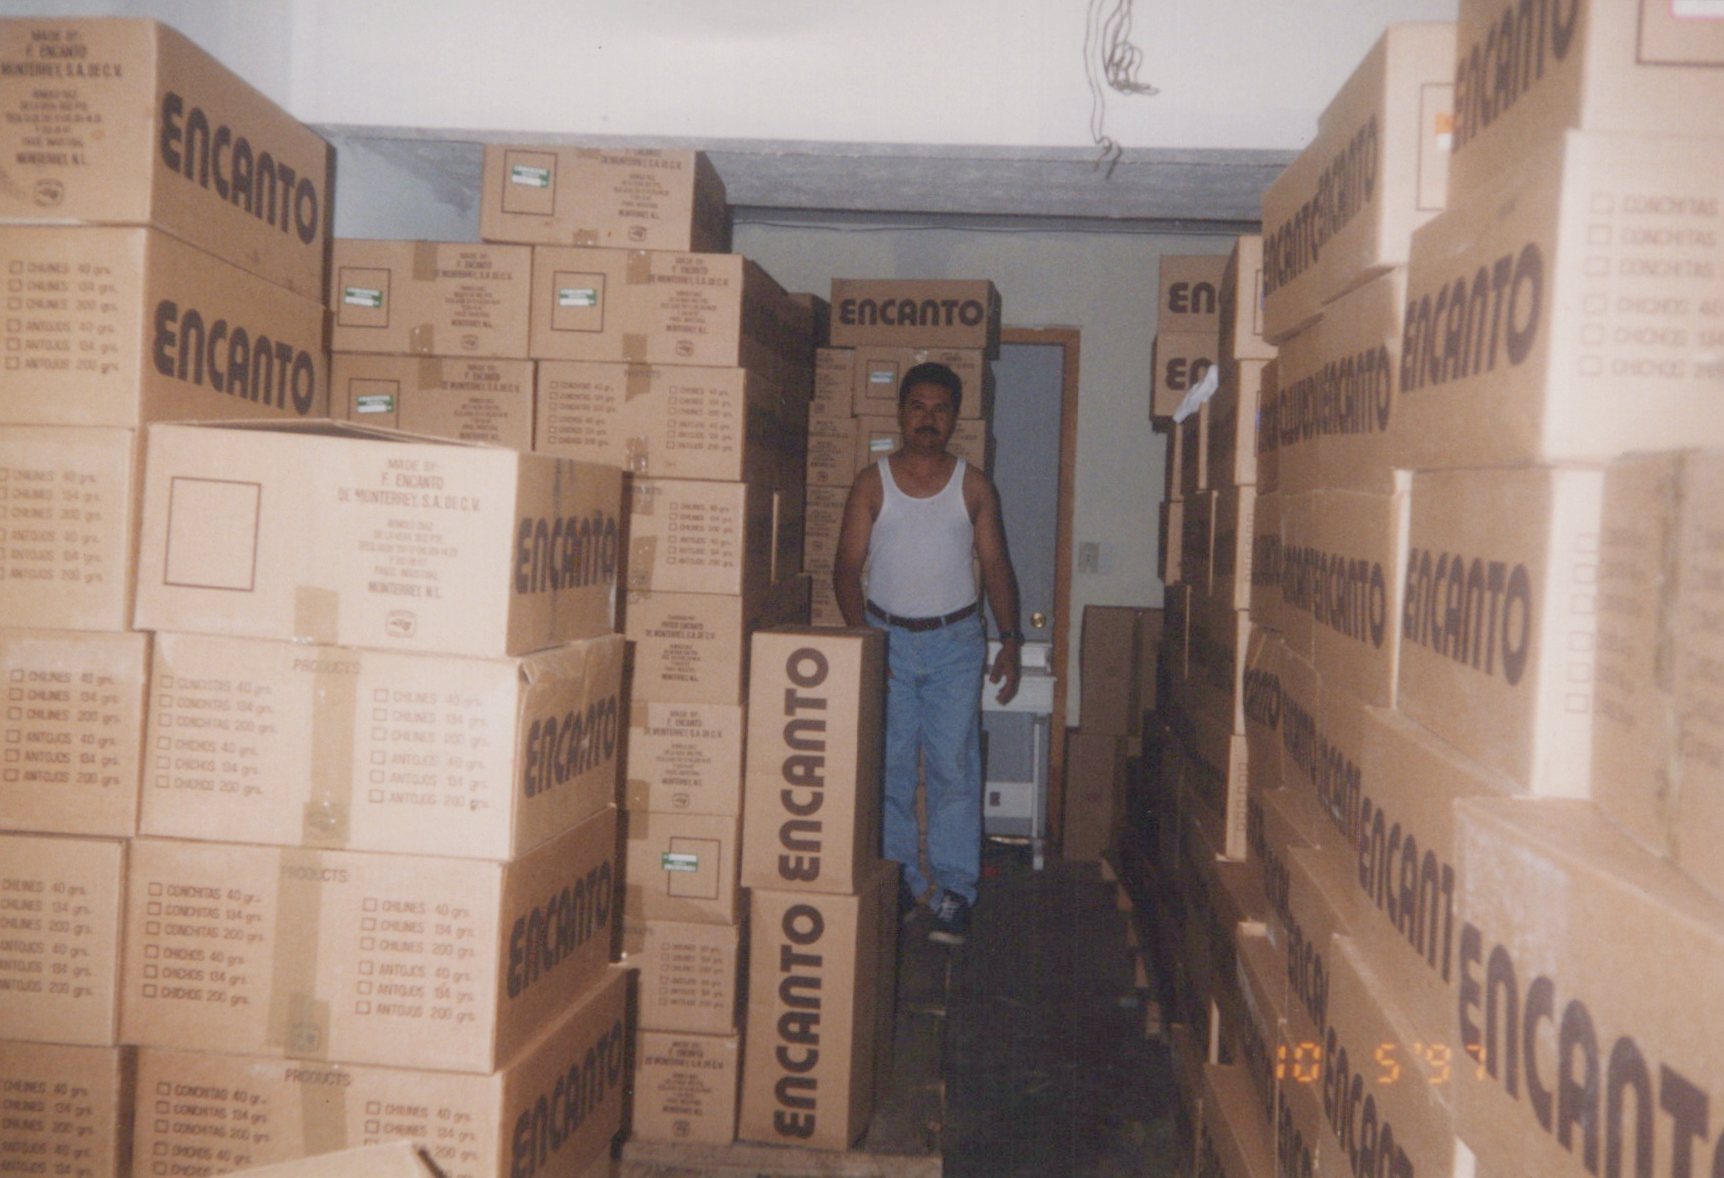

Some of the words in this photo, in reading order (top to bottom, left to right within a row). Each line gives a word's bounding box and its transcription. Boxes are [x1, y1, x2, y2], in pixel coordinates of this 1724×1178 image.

[160, 90, 318, 246] ENCANTO
[838, 297, 986, 328] ENCANTO
[1400, 242, 1546, 394] ENCANTO
[154, 298, 316, 416] ENCANTO
[395, 472, 445, 491] ENCANTO
[514, 512, 618, 595] ENCANTO
[1403, 546, 1533, 687] ENCANTO
[293, 659, 362, 675] PRODUCTS
[525, 693, 618, 799] ENCANTO
[778, 645, 830, 883] ENCANTO
[166, 884, 221, 900] CONCHITAS
[227, 889, 241, 901] 40
[165, 904, 220, 919] CONCHITAS
[226, 908, 243, 920] 134
[164, 923, 219, 938] CONCHITAS
[223, 928, 244, 940] 200
[507, 858, 612, 998] ENCANTO
[163, 947, 205, 961] CHICHOS
[209, 950, 225, 963] 40
[161, 966, 204, 981] CHICHOS
[210, 970, 226, 982] 134
[161, 986, 202, 1001] CHICHOS
[206, 990, 227, 1003] 200
[774, 903, 826, 1139] ENCANTO
[1455, 919, 1724, 1178] ENCANT
[284, 1067, 352, 1087] PRODUCTS
[174, 1083, 228, 1101] CONCHITAS
[232, 1089, 248, 1102] 40
[512, 1009, 623, 1178] ENCANTO
[174, 1103, 227, 1119] CONCHITAS
[172, 1122, 226, 1138] CONCHITAS
[216, 1149, 231, 1162] 40
